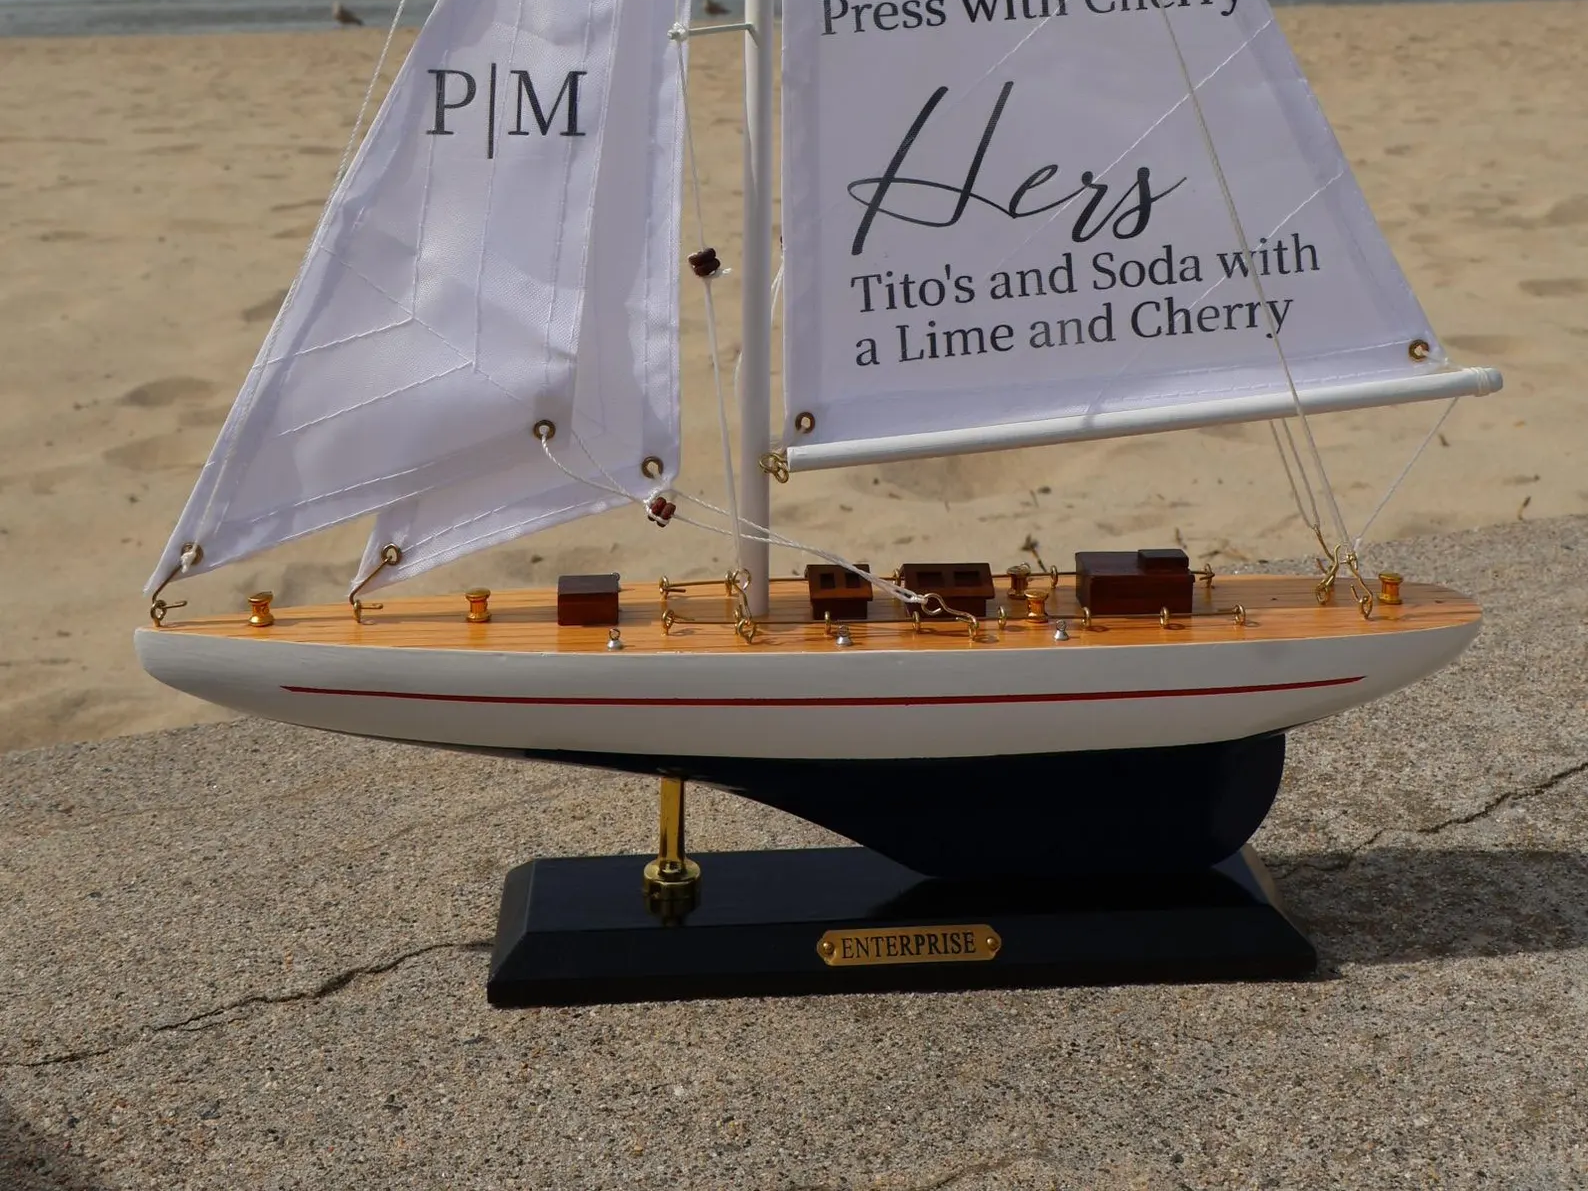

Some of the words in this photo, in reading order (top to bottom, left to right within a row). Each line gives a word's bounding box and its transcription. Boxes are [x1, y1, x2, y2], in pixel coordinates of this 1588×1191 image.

[847, 81, 1187, 256] Hers
[851, 264, 976, 313] Tito's
[989, 252, 1076, 299] and
[1091, 244, 1203, 291] Soda
[1217, 233, 1320, 280] with
[855, 336, 881, 366] a
[896, 319, 1015, 364] Lime
[1028, 303, 1117, 349] and
[1130, 295, 1294, 340] Cherry
[841, 932, 977, 959] ENTERPRISE
